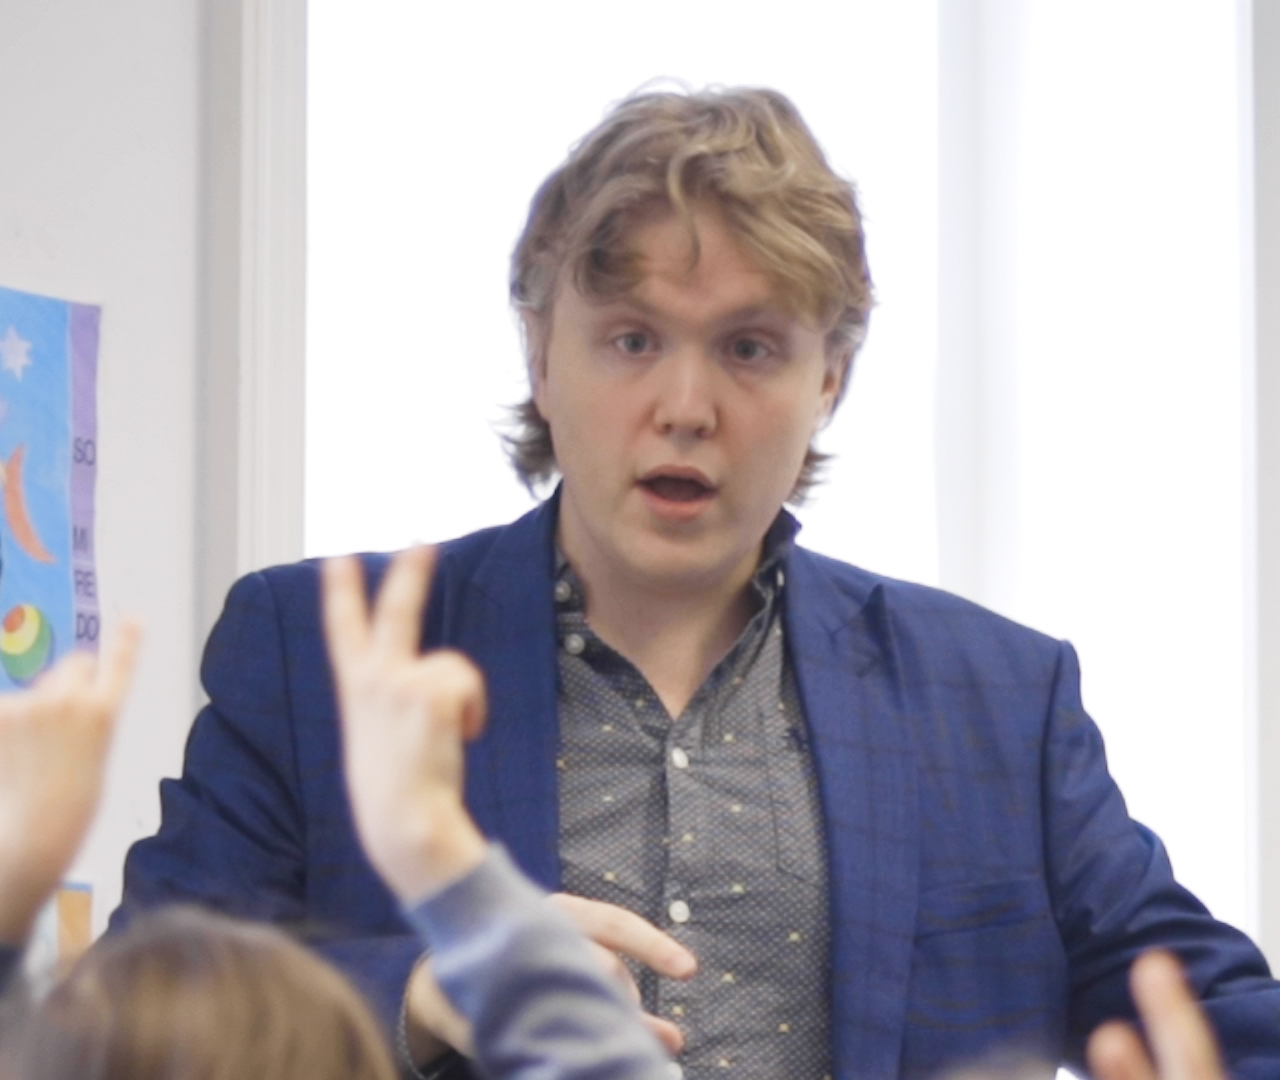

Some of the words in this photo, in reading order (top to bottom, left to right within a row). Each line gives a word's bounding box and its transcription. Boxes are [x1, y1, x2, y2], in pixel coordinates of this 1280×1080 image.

[73, 437, 96, 466] SO
[74, 569, 95, 598] RE
[76, 613, 99, 641] DO
